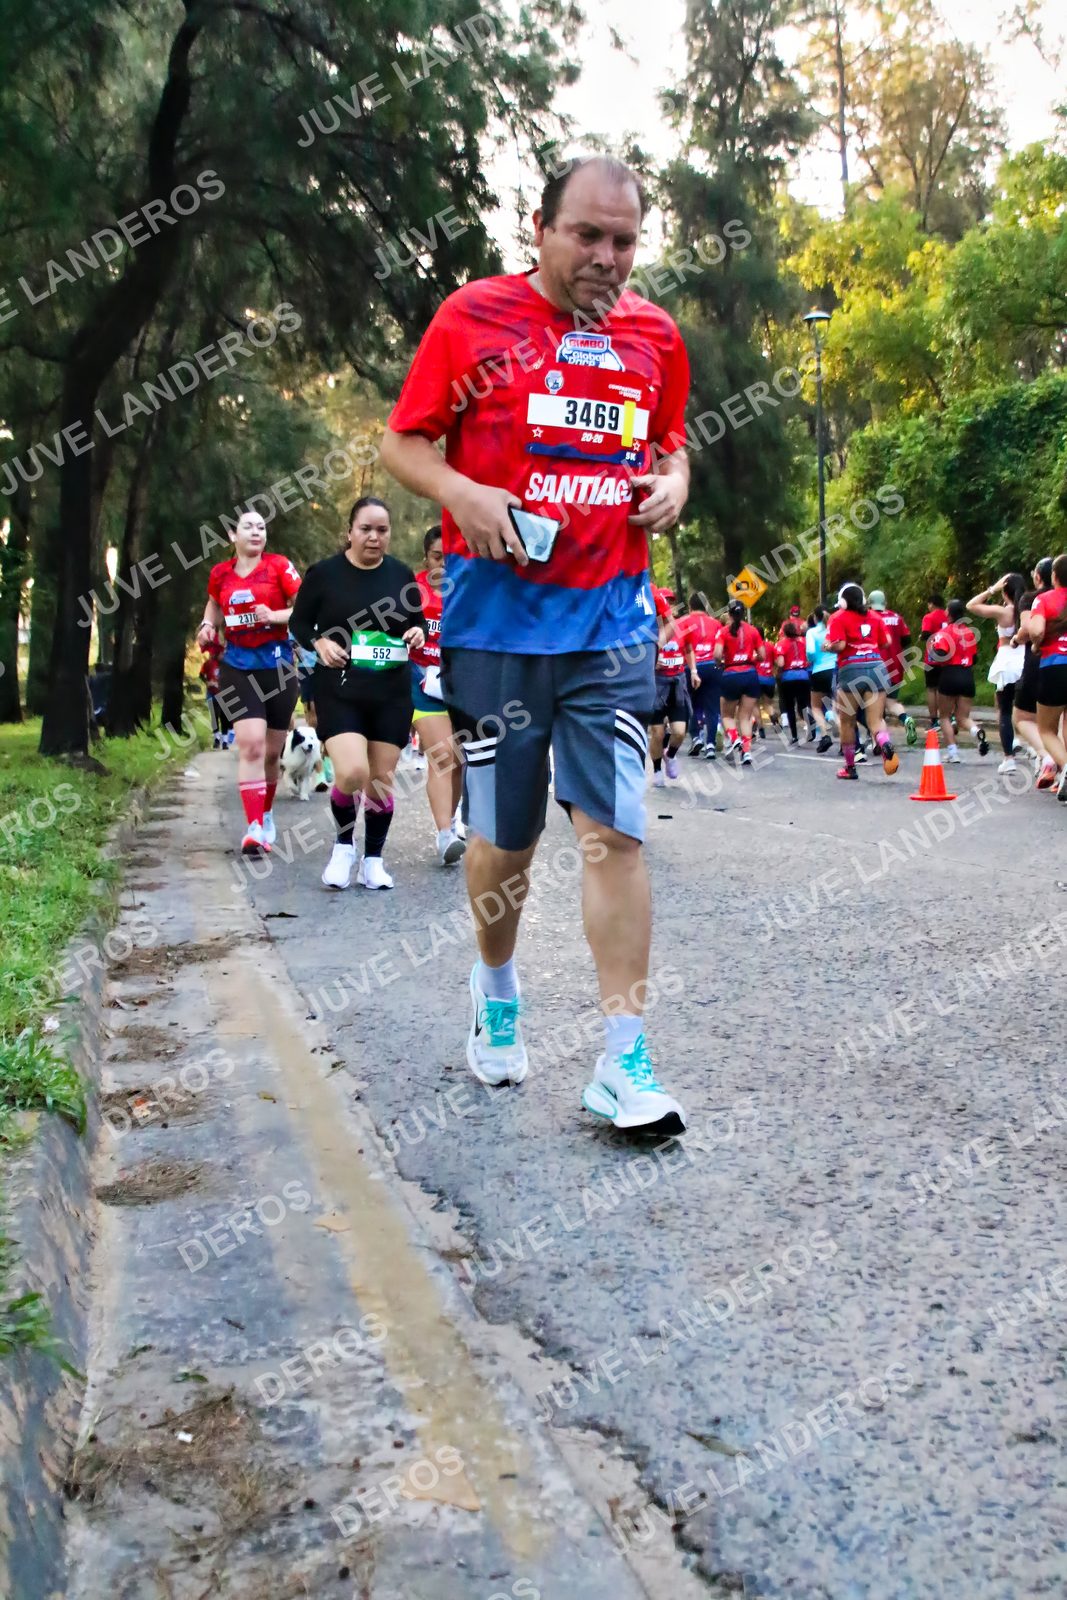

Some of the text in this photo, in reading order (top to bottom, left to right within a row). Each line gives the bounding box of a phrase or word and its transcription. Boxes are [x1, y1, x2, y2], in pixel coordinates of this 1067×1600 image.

[569, 339, 605, 349] BIMBO
[572, 351, 605, 362] Global
[565, 400, 620, 431] 3469
[626, 452, 636, 461] 5K
[525, 473, 632, 505] SANTIAG
[373, 648, 391, 660] 552
